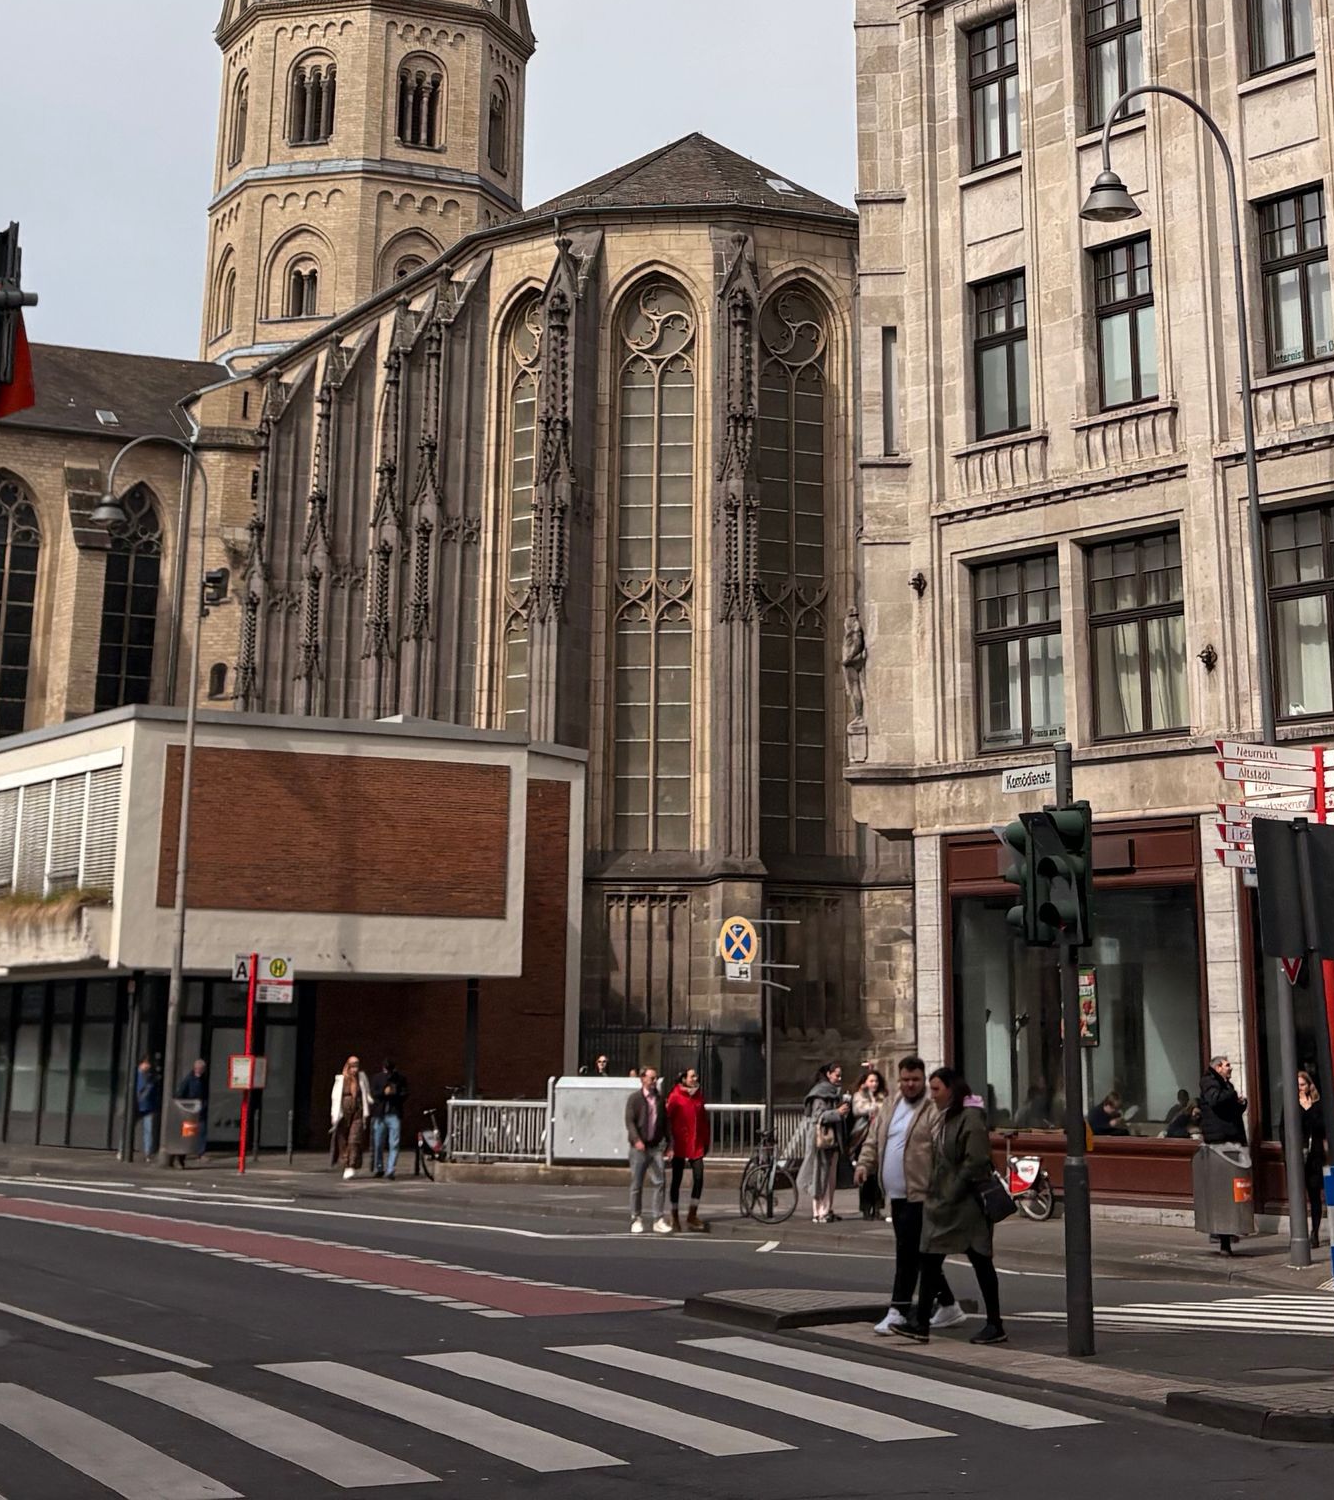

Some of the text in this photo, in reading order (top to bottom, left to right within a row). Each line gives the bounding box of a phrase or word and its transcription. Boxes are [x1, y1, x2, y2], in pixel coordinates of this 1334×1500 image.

[1236, 746, 1278, 760] Neumarkt
[1238, 767, 1271, 780] Altstadt
[1238, 854, 1255, 865] WD
[235, 961, 247, 978] A
